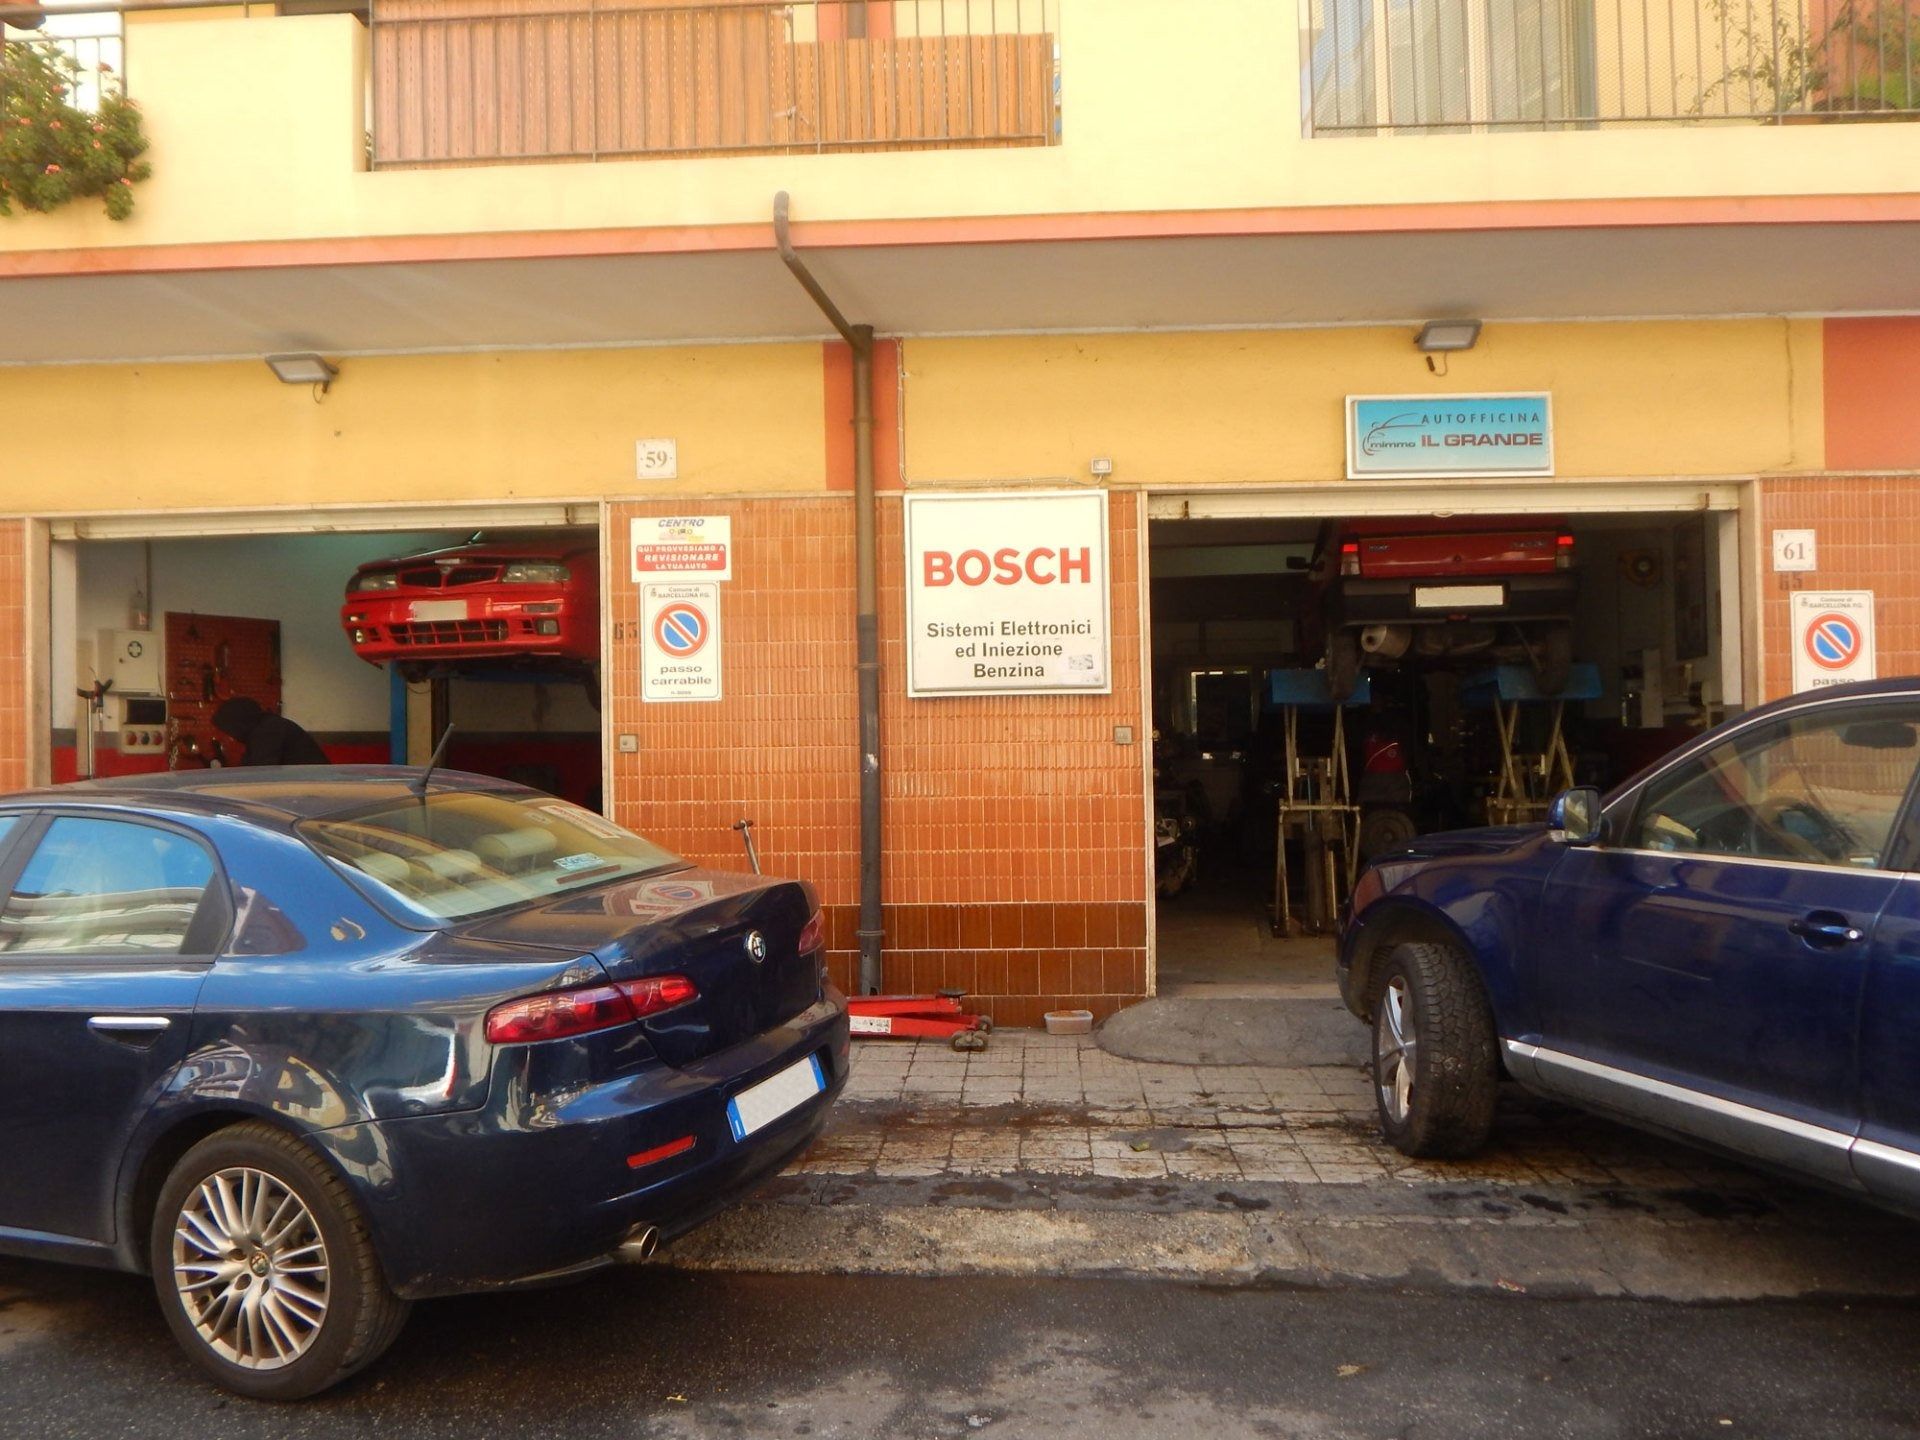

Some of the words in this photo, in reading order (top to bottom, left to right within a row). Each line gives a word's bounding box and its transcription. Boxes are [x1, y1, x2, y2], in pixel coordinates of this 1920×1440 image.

[1421, 412, 1540, 424] AUTOFFICINA
[1370, 440, 1416, 448] mimmo
[1421, 434, 1440, 447] IL
[1444, 432, 1543, 447] GRANDE
[645, 450, 668, 469] 59
[658, 518, 705, 528] CENTRO
[643, 553, 719, 562] REVISIONARE
[1783, 542, 1806, 561] 61
[923, 547, 1091, 588] BOSCH
[927, 622, 994, 638] Sistemi
[1001, 620, 1092, 636] Elettronici
[955, 643, 976, 658] ed
[982, 641, 1063, 657] Iniezione
[660, 665, 703, 675] passo
[974, 662, 1045, 678] Benzina
[651, 676, 712, 686] carrabile
